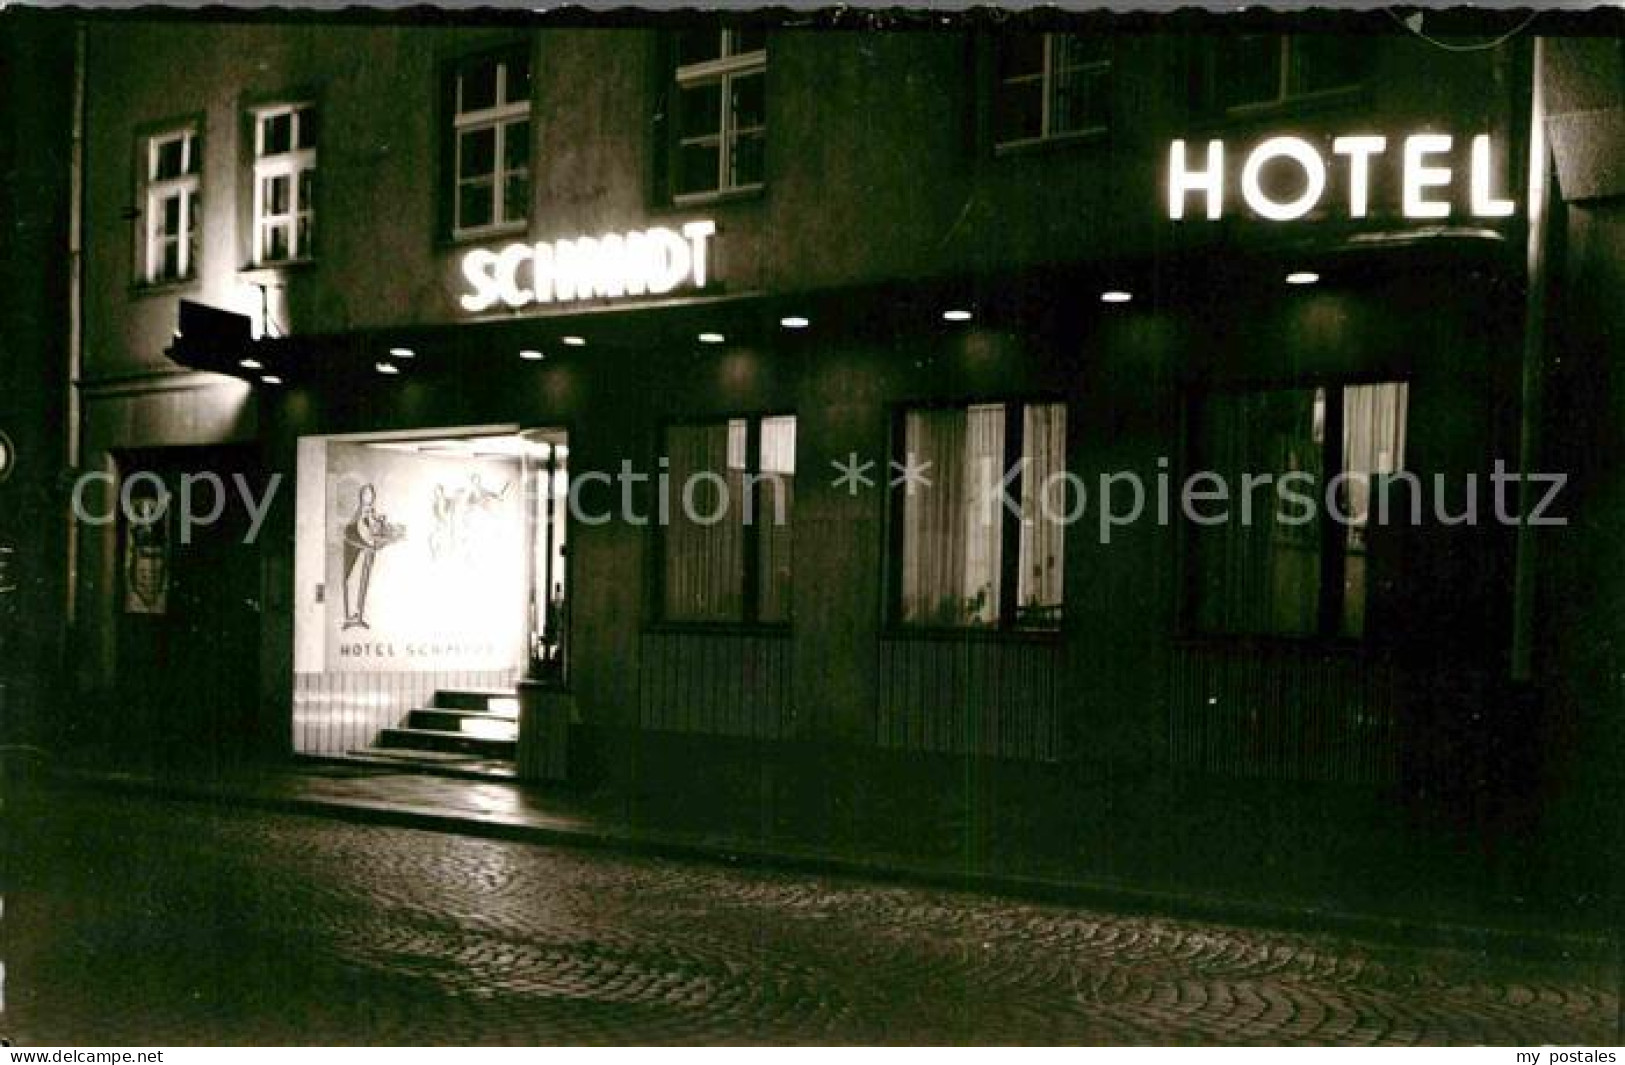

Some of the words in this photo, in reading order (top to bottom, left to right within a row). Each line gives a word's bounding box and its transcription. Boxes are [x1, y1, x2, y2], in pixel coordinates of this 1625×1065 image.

[1169, 134, 1514, 221] HOTEL
[461, 220, 716, 312] SCHMIDT
[340, 642, 395, 657] HOTEL
